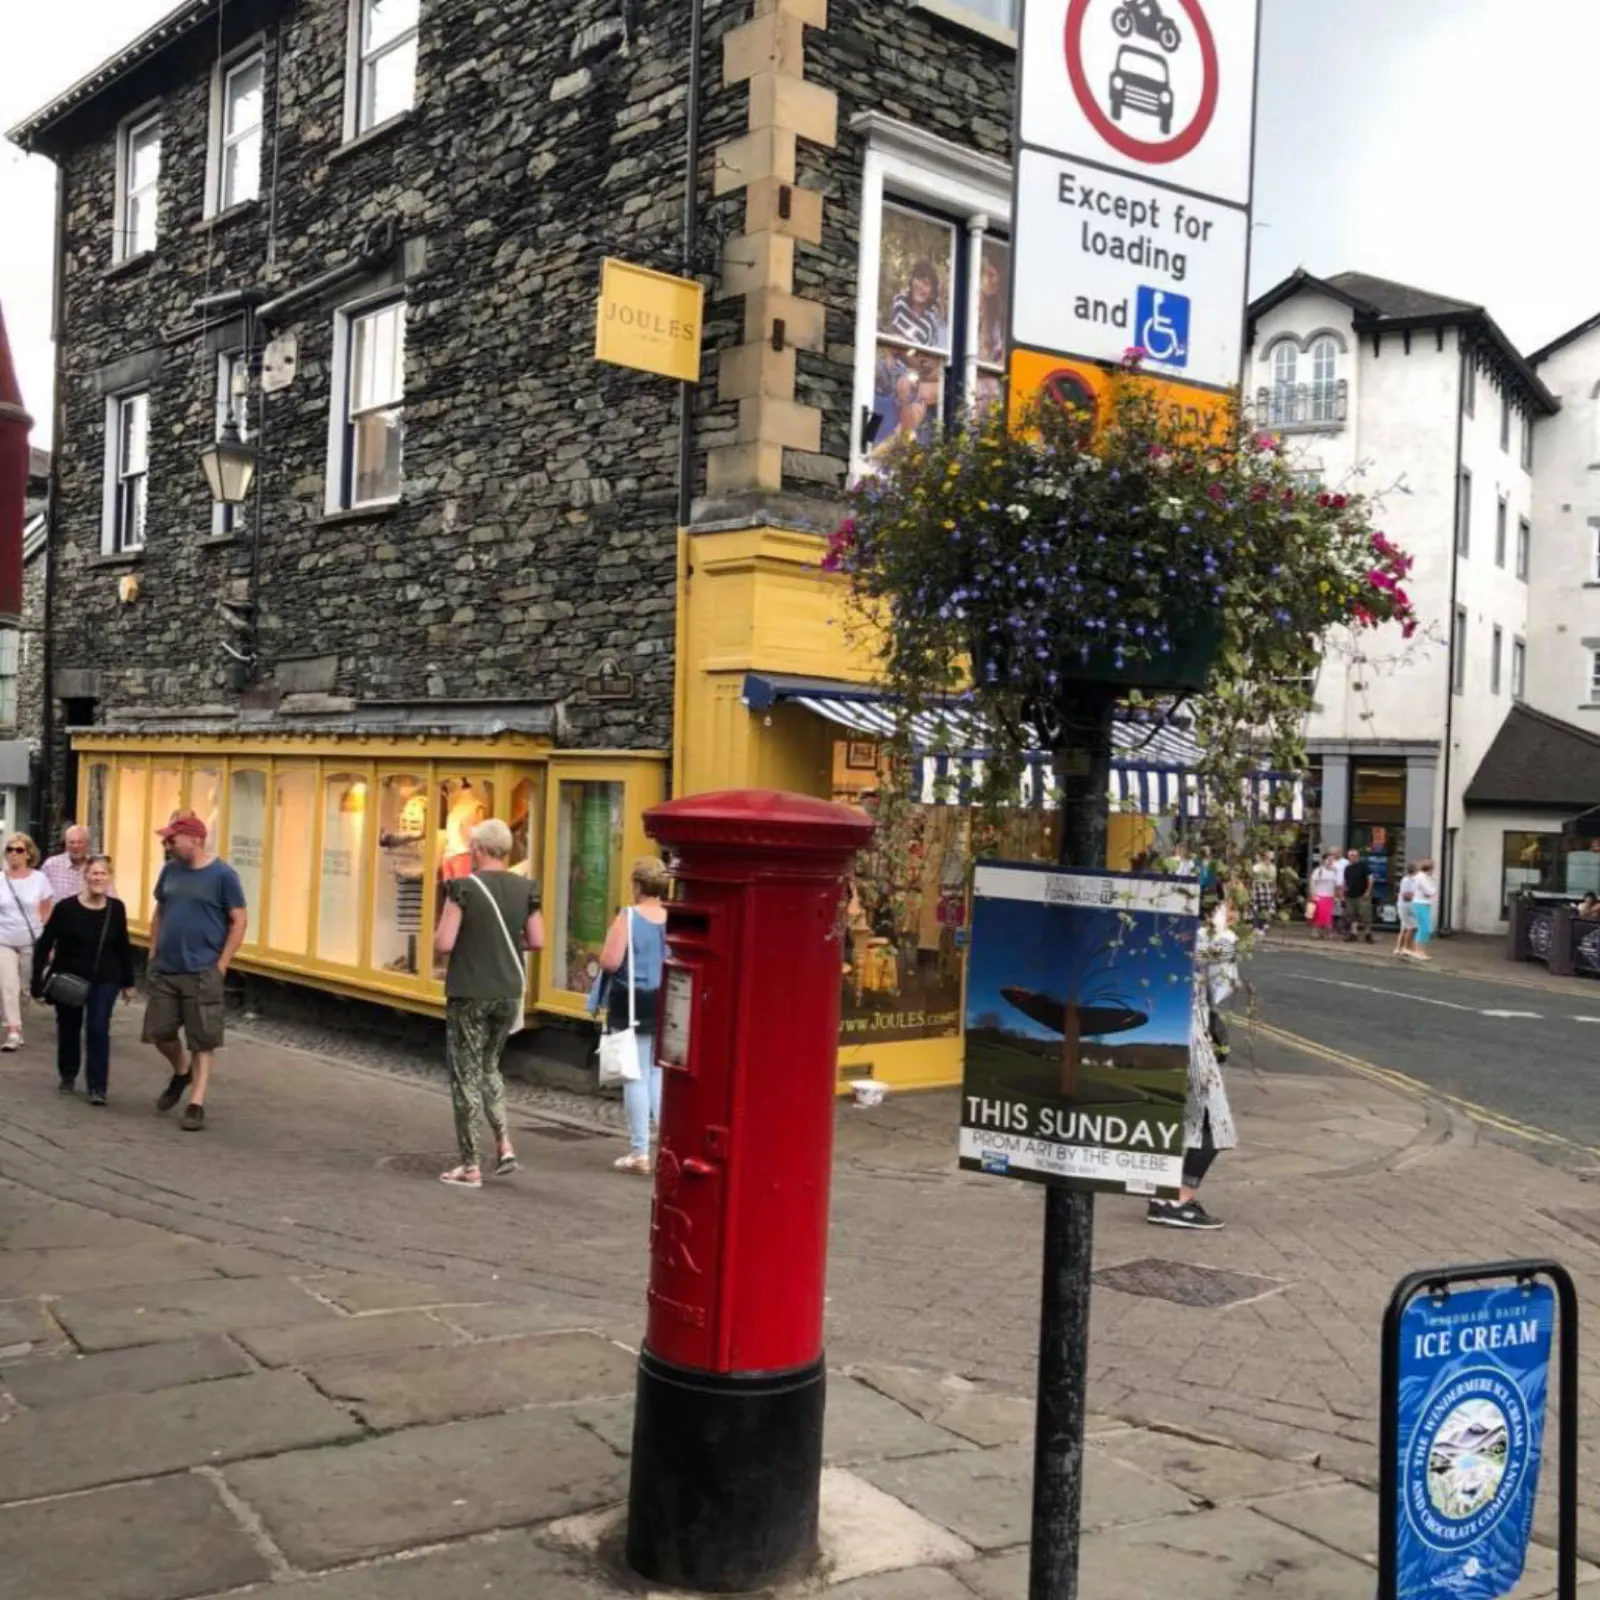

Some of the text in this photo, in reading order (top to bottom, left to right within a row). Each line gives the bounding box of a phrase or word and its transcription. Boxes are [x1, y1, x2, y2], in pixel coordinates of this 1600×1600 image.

[1058, 172, 1213, 242] Except for
[1081, 220, 1187, 281] loading
[605, 302, 695, 341] JOULES
[1074, 295, 1128, 328] and
[967, 1096, 1179, 1150] THIS SUNDAY
[1058, 1146, 1079, 1163] BY
[1083, 1149, 1110, 1166] THE
[1115, 1152, 1169, 1173] GLEBE
[1414, 1318, 1539, 1360] ICE CREAM
[1413, 1436, 1430, 1466] THE
[1477, 1460, 1520, 1528] COMPANY
